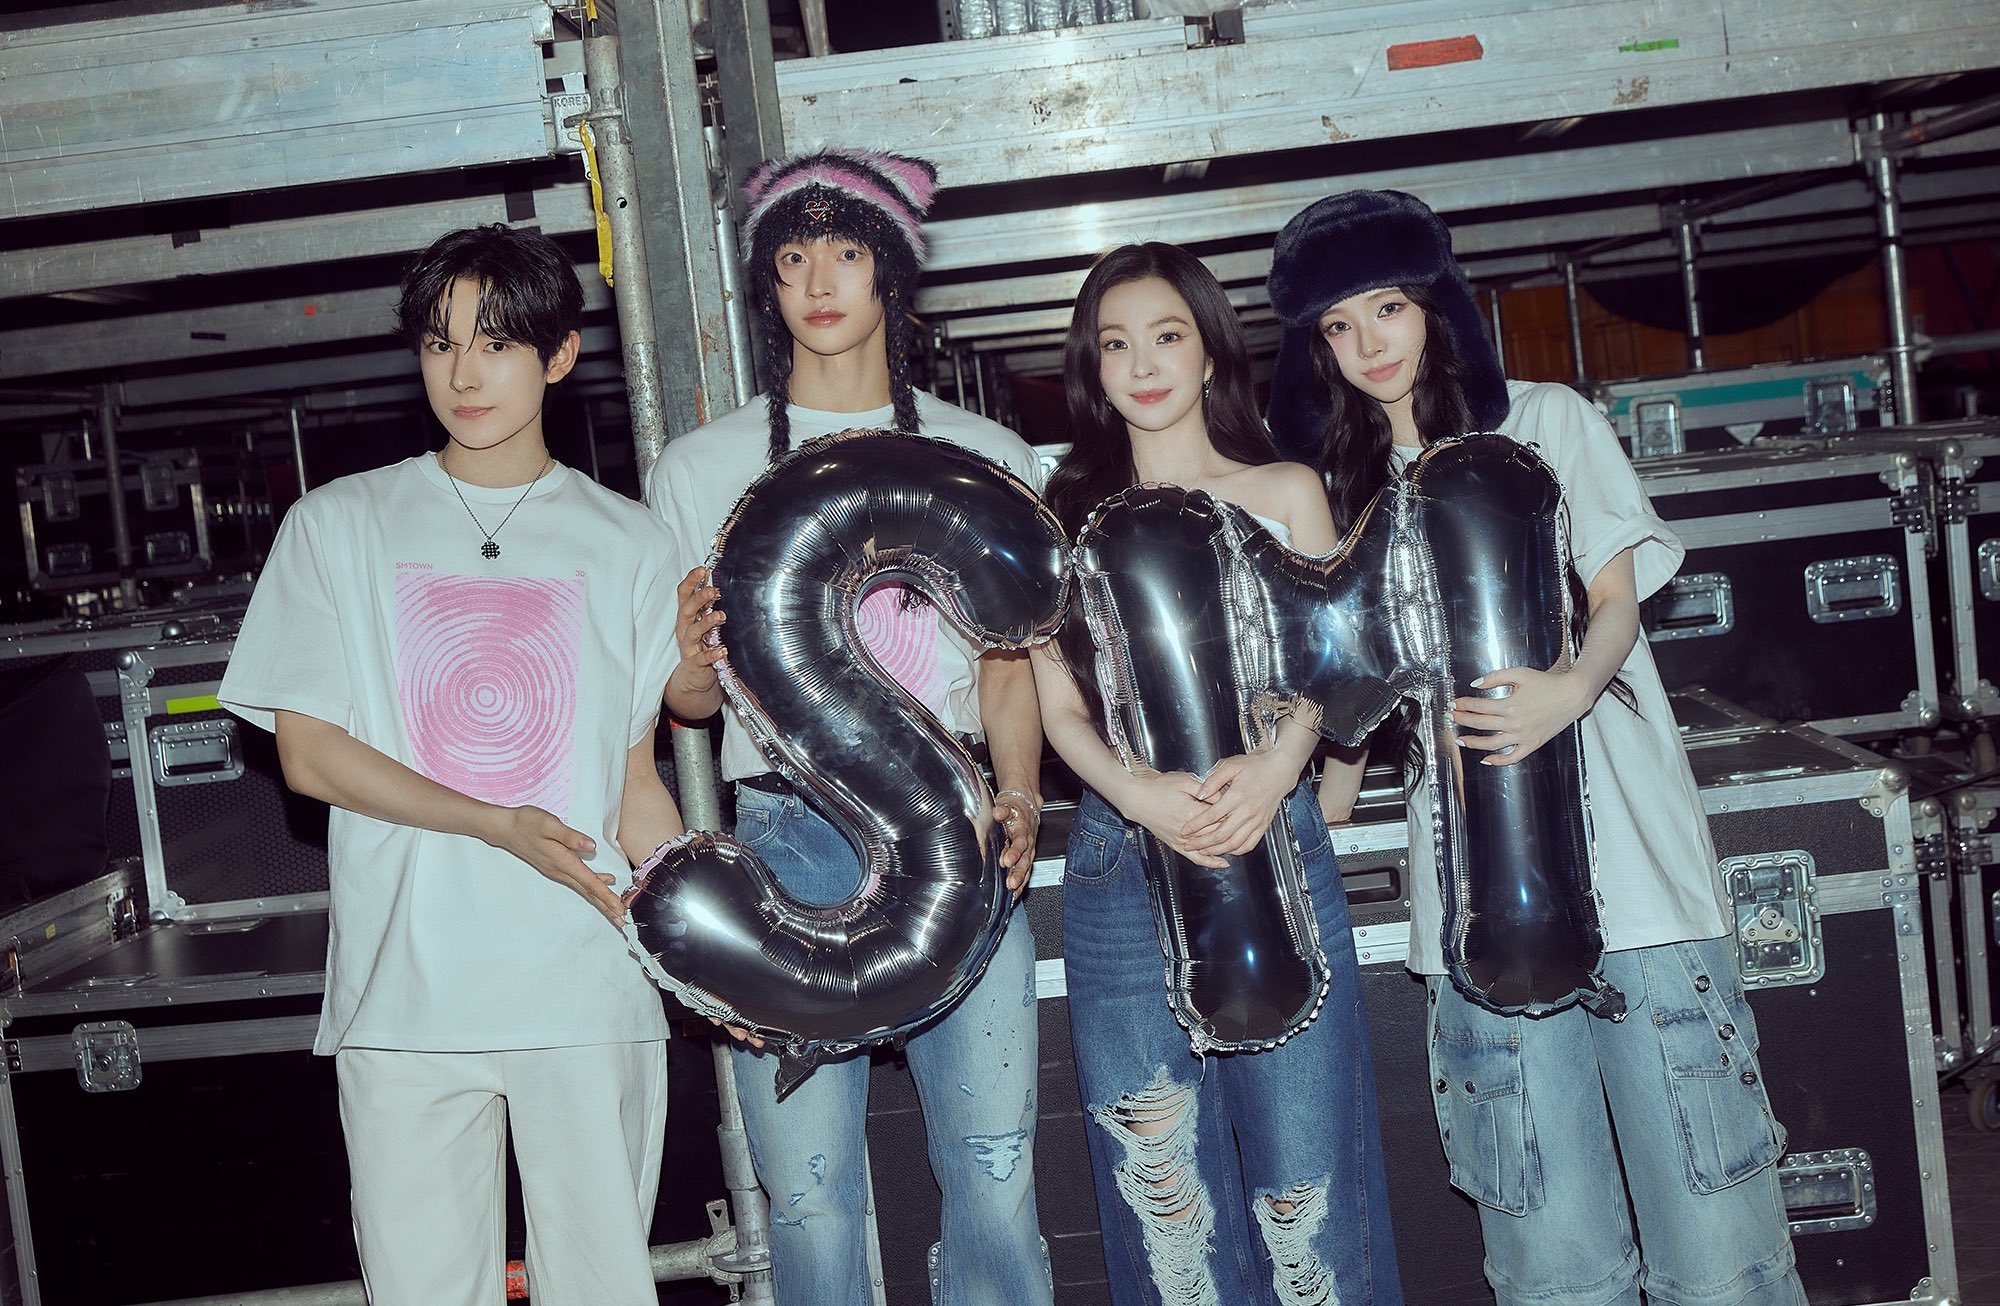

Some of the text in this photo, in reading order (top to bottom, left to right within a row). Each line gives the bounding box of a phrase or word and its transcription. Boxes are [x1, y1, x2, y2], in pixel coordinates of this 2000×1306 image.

[554, 96, 588, 107] KOREA
[395, 562, 433, 570] SMTOWN
[575, 569, 586, 577] 30
